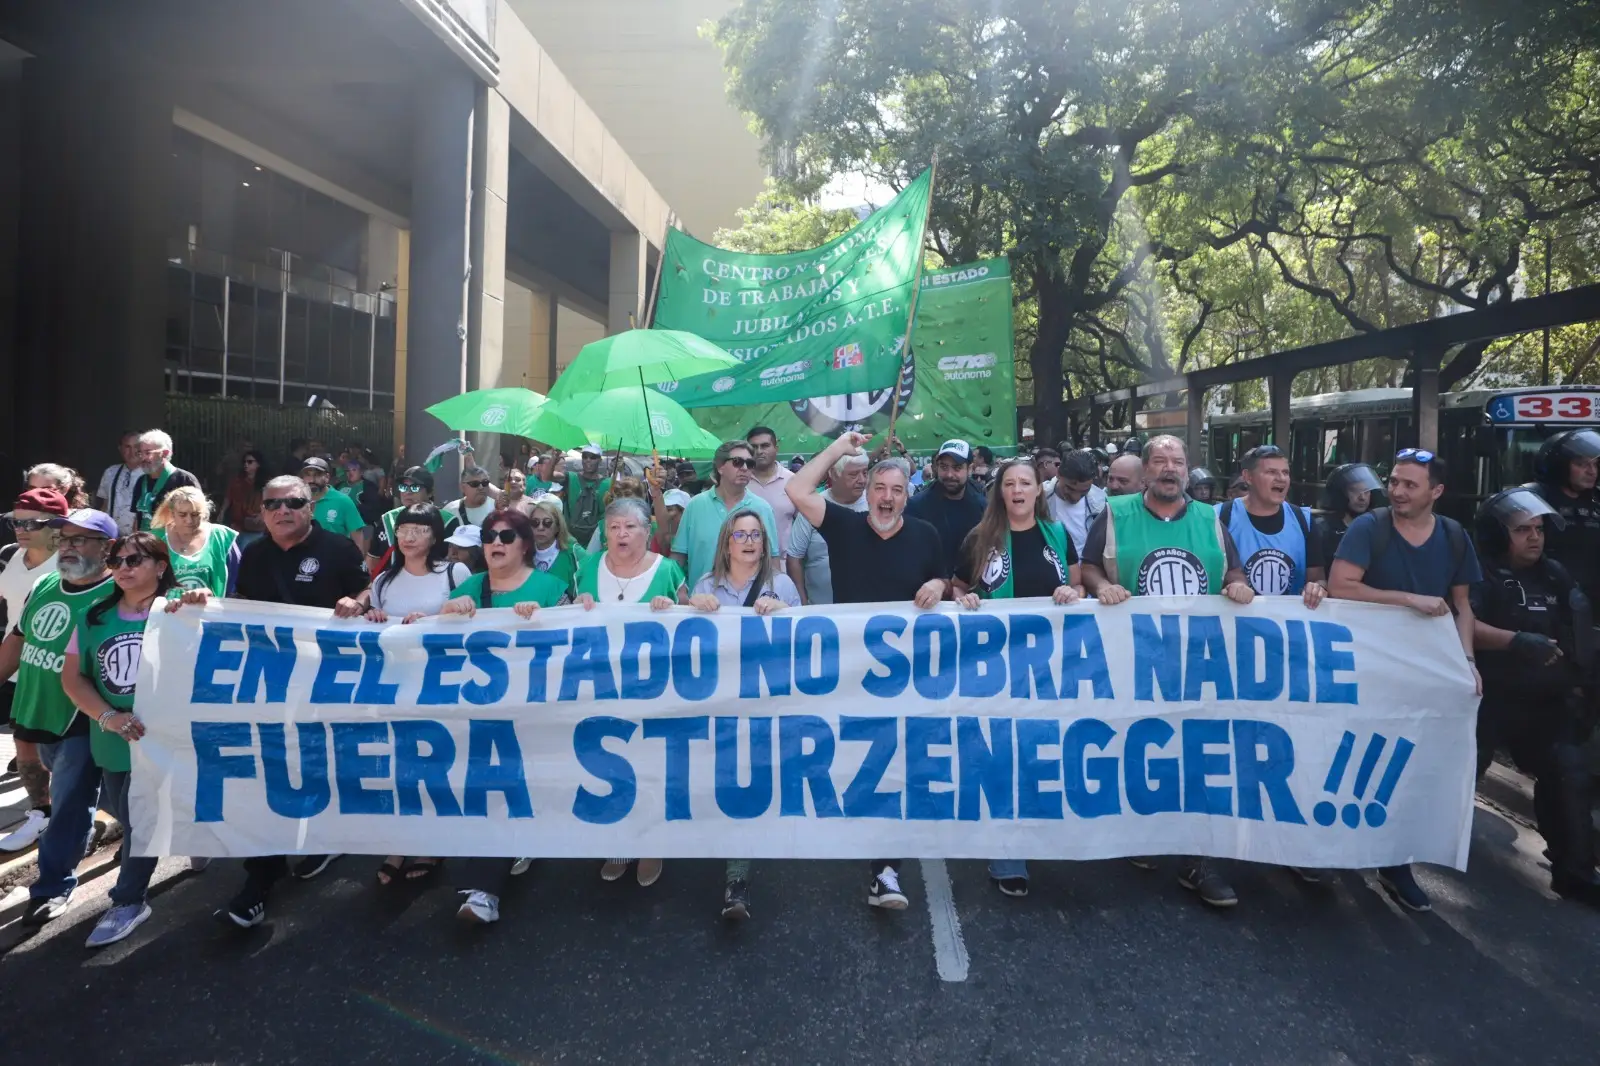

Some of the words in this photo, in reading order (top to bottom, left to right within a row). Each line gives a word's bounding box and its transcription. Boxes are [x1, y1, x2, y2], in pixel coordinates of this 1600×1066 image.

[703, 258, 790, 281] CENTRO
[932, 266, 989, 286] ESTADO
[703, 288, 731, 305] DE
[847, 278, 861, 295] Y
[843, 297, 900, 329] A.T.E.
[761, 372, 805, 388] autónoma
[943, 369, 992, 381] autónoma
[1518, 397, 1592, 418] 33
[1166, 549, 1187, 558] AÑOS
[1267, 550, 1285, 558] AÑOS
[1150, 561, 1193, 595] ATE
[1253, 560, 1289, 593] ATE
[34, 605, 67, 638] ATE
[20, 642, 66, 673] RISSO
[191, 622, 298, 703] EN
[310, 629, 399, 704] EL
[416, 617, 719, 705] ESTADO
[739, 616, 840, 699] NO
[861, 614, 1115, 700] SOBRA
[1131, 614, 1359, 704] NADIE
[191, 719, 535, 822] FUERA
